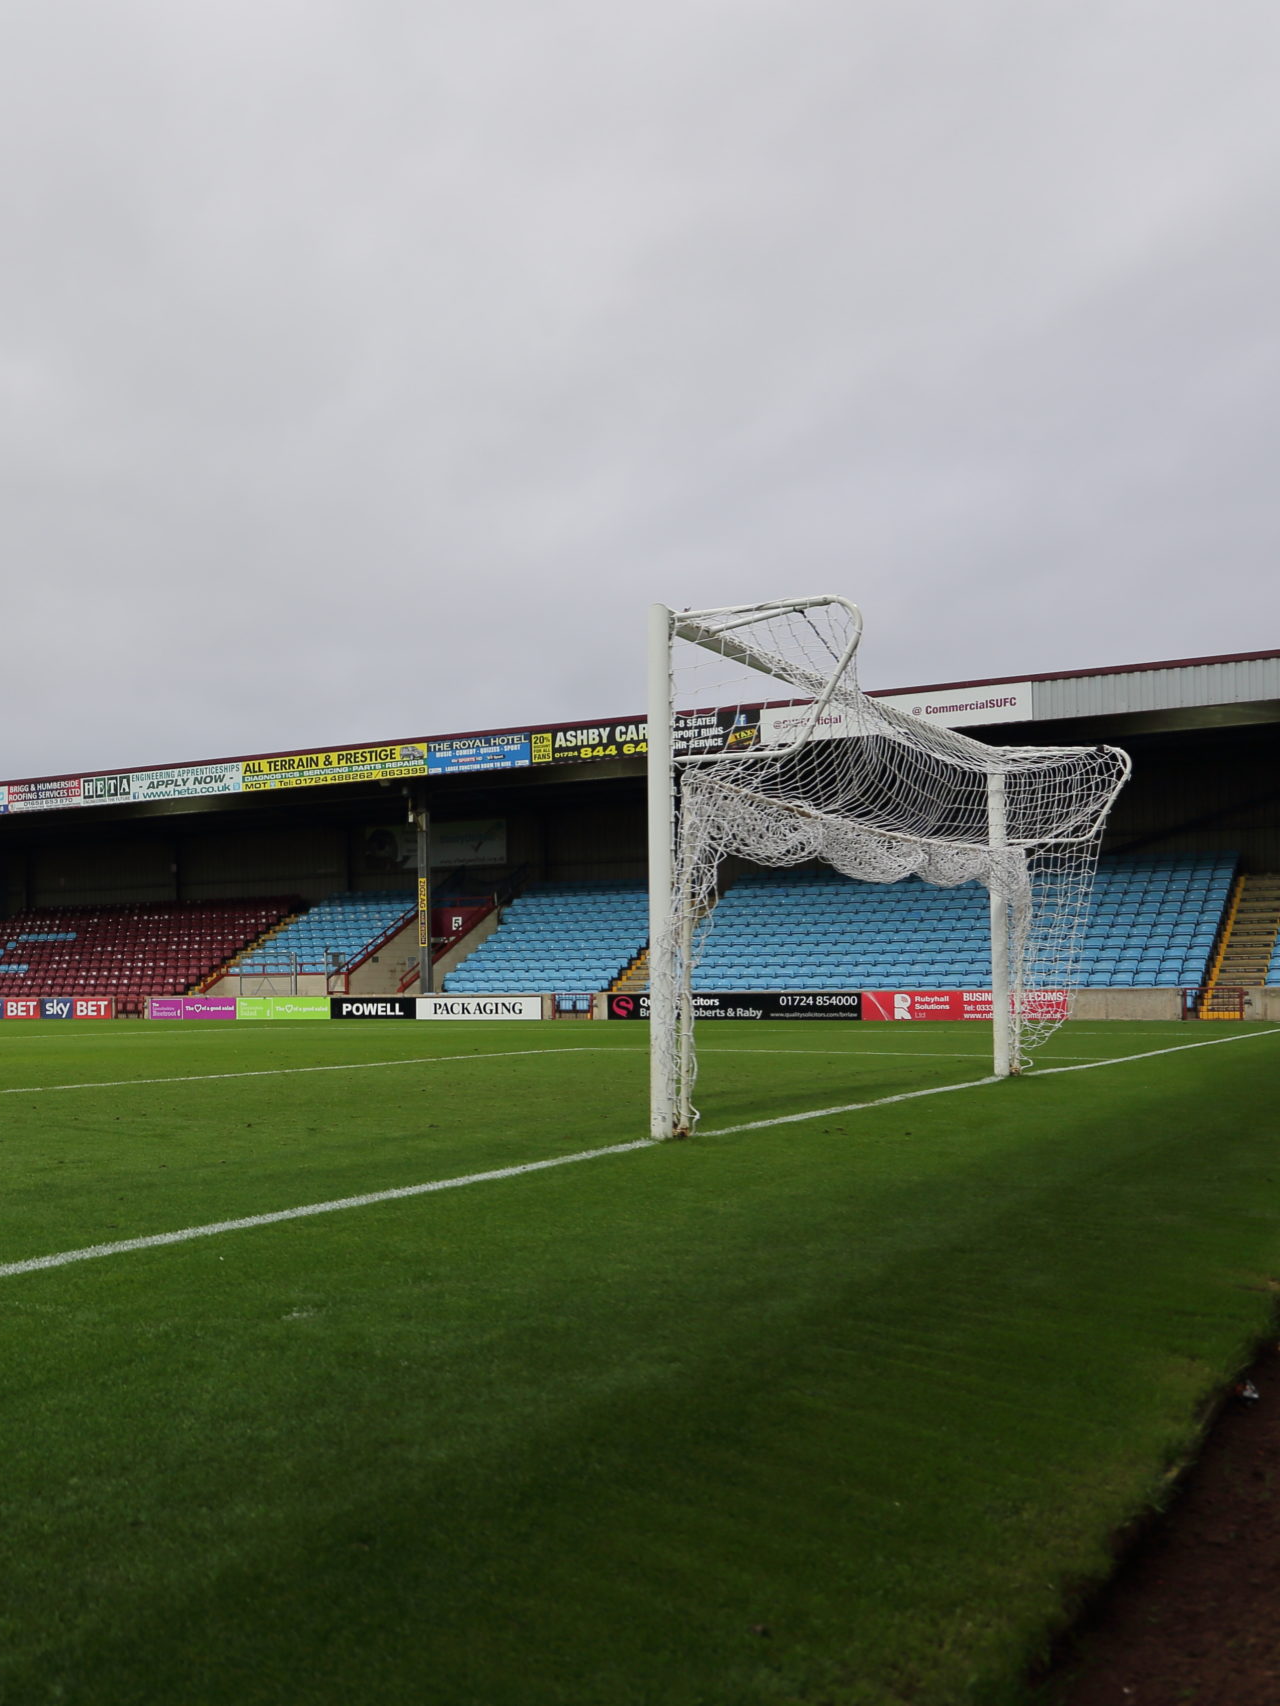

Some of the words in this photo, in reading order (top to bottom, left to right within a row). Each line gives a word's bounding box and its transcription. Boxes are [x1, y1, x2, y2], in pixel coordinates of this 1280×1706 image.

[925, 697, 1017, 715] CommercialSUFC
[686, 717, 717, 727] SEATER
[555, 727, 610, 748] ASHBY
[614, 723, 649, 742] CAR
[672, 729, 700, 739] RPORT
[429, 742, 451, 752] THE
[453, 739, 489, 750] ROYAL
[490, 735, 529, 746] HOTEL
[580, 746, 618, 758] 844
[623, 743, 648, 755] 64
[244, 762, 264, 774] ALL
[267, 756, 319, 772] TERRAIN
[323, 755, 333, 766] &
[337, 748, 397, 765] PRESTIGE
[303, 767, 349, 776] SERVICING
[352, 763, 381, 771] PARTS
[386, 759, 425, 768] REPAIRS
[131, 771, 175, 782] ENGINEERING
[177, 764, 240, 777] APPRENTICESHIPS
[10, 785, 29, 793] BRIGG
[37, 780, 79, 791] HUMBERSIDE
[83, 778, 130, 797] HETA
[147, 778, 190, 790] APPLY
[193, 774, 226, 785] NOW
[245, 782, 268, 790] MOT
[295, 776, 328, 785] 01724
[8, 792, 37, 801] ROOFING
[38, 790, 68, 799] SERVICES
[69, 788, 81, 796] LTD
[142, 783, 231, 799] www.heta.co.uk
[454, 918, 461, 928] 5
[779, 996, 814, 1006] 01724
[816, 995, 858, 1006] 854000
[915, 995, 949, 1003] Rubyhall
[6, 1002, 37, 1016] BET
[45, 1001, 70, 1017] sky
[76, 1001, 108, 1016] BET
[342, 1003, 404, 1015] POWELL
[433, 1001, 523, 1016] PACKAGING
[693, 1008, 726, 1017] oberts
[727, 1009, 735, 1017] &
[737, 1008, 763, 1019] Raby
